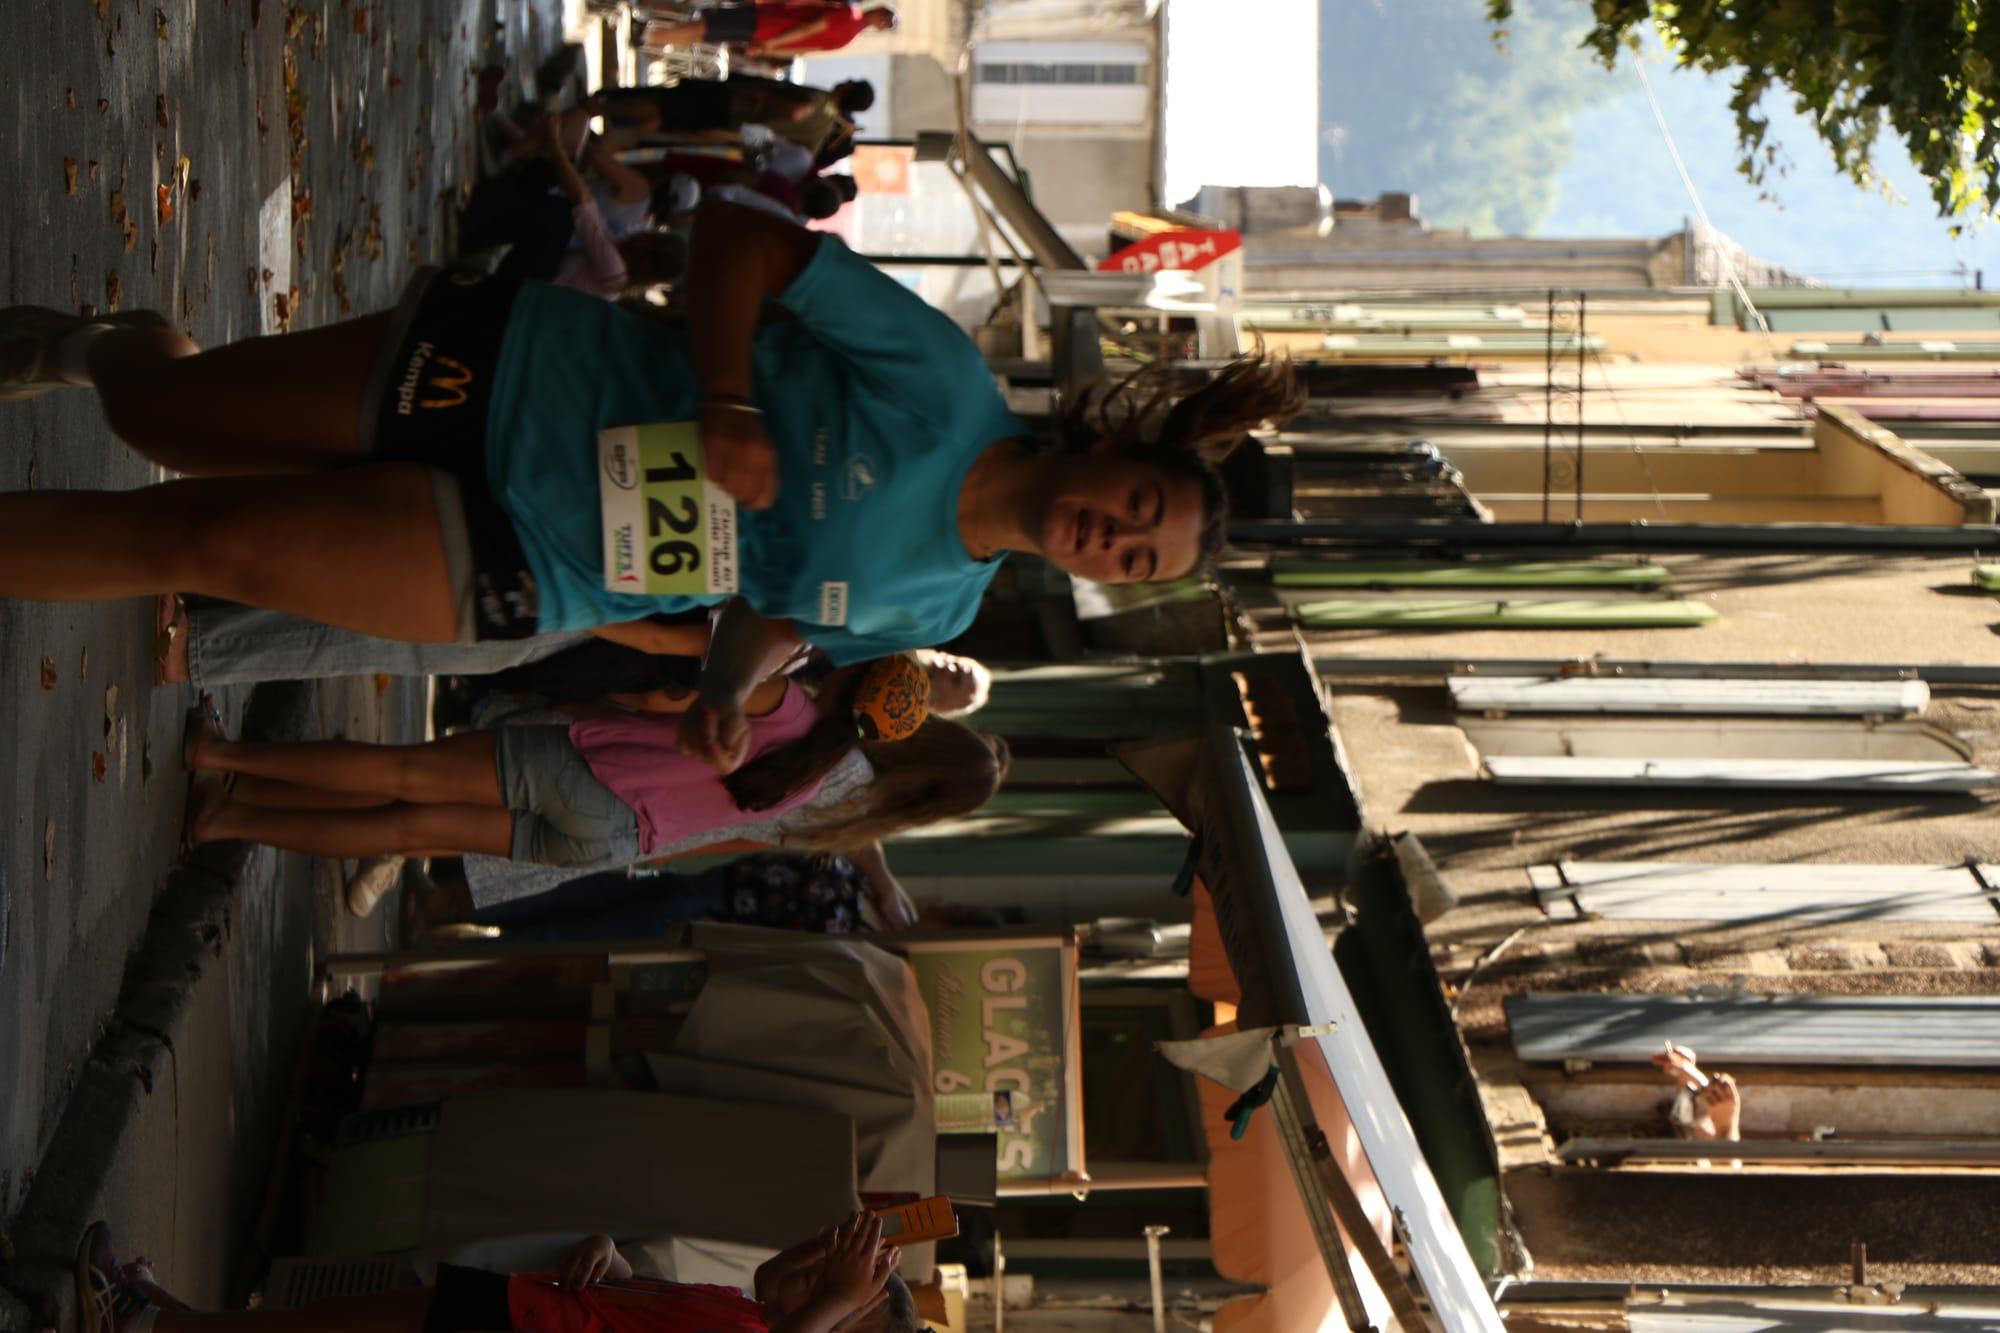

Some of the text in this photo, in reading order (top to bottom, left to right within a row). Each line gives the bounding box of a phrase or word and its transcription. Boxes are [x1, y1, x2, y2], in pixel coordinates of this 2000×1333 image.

[1122, 238, 1215, 273] TABAC
[396, 340, 436, 416] Kempa
[645, 452, 701, 576] 126
[934, 1069, 971, 1093] 6
